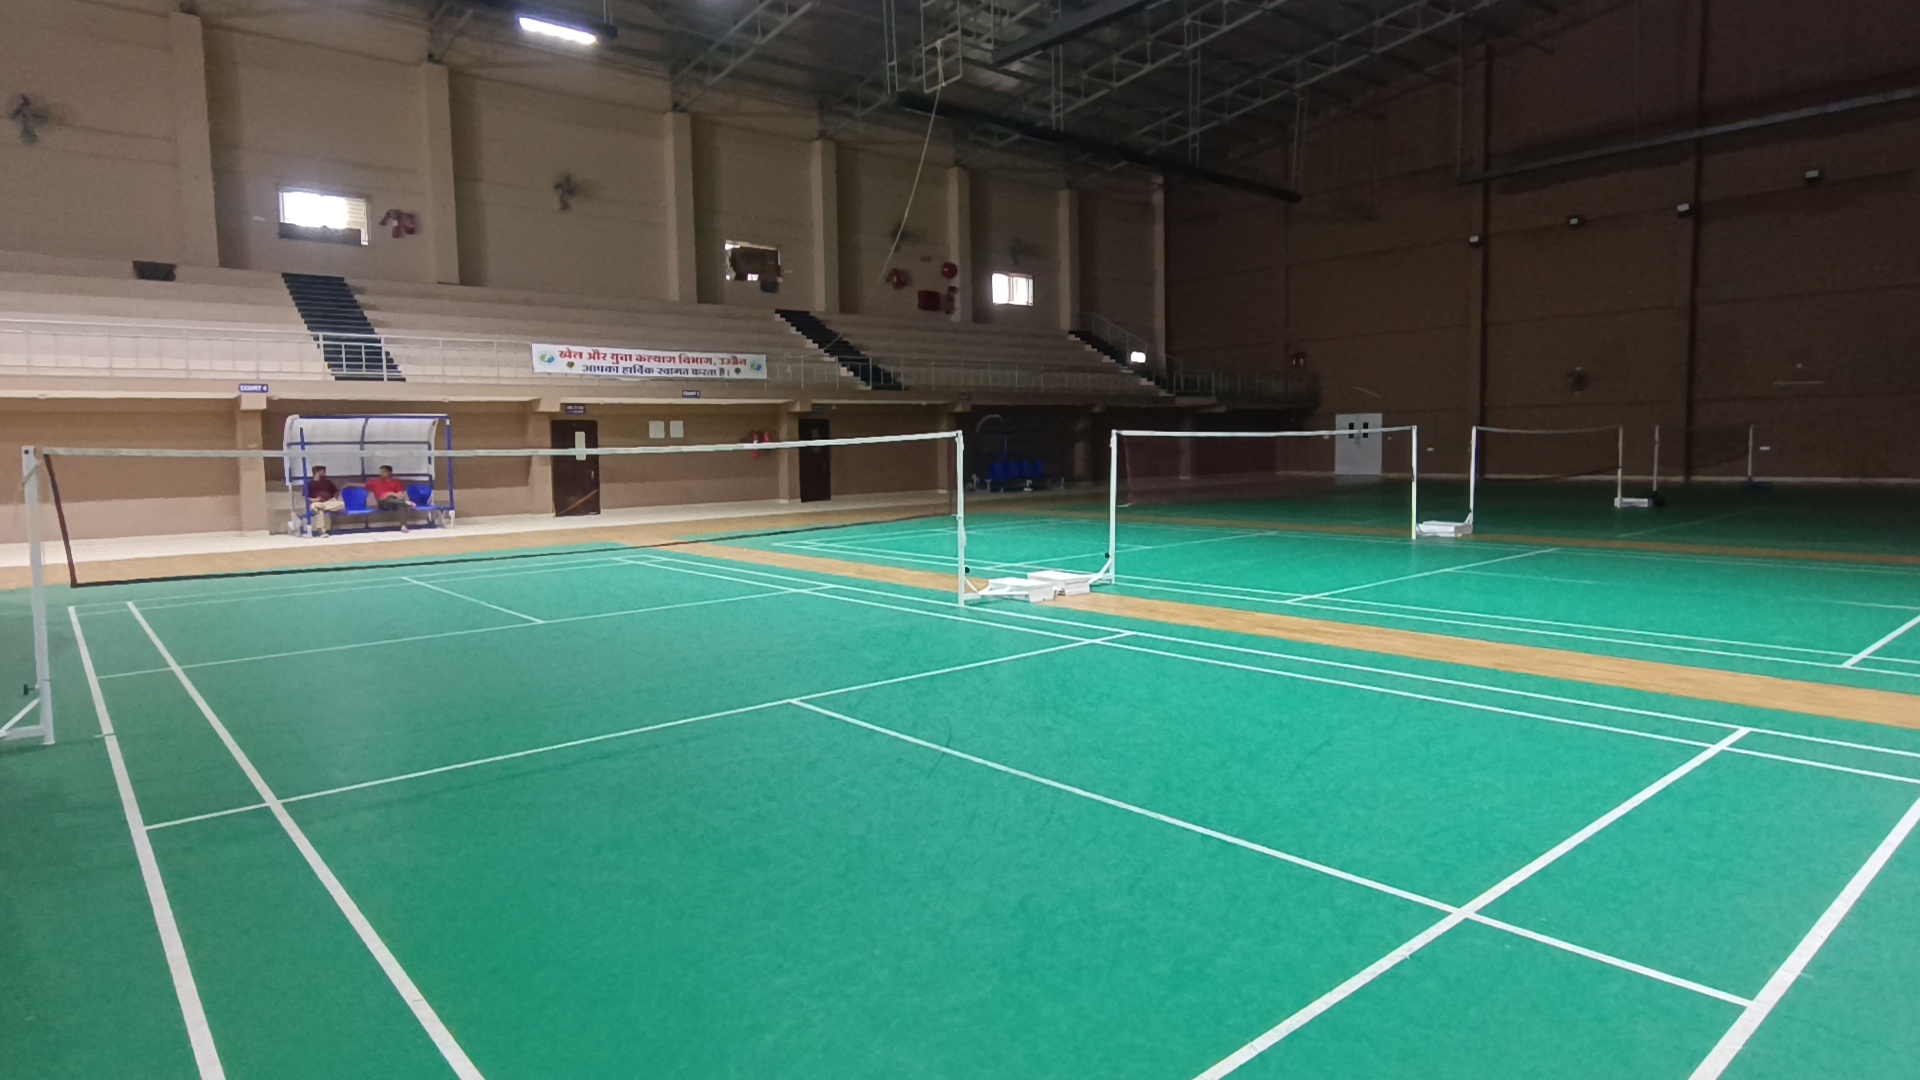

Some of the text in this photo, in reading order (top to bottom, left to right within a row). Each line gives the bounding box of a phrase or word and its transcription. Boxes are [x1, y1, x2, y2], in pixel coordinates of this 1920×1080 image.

[558, 347, 583, 360] खेल
[587, 348, 607, 361] और
[610, 352, 633, 365] युवा
[635, 353, 676, 363] कल्याण
[678, 353, 717, 366] विभाग,
[582, 364, 619, 373] आपका
[621, 364, 654, 375] हार्दिक
[656, 367, 689, 375] स्वागत
[691, 368, 717, 376] करता
